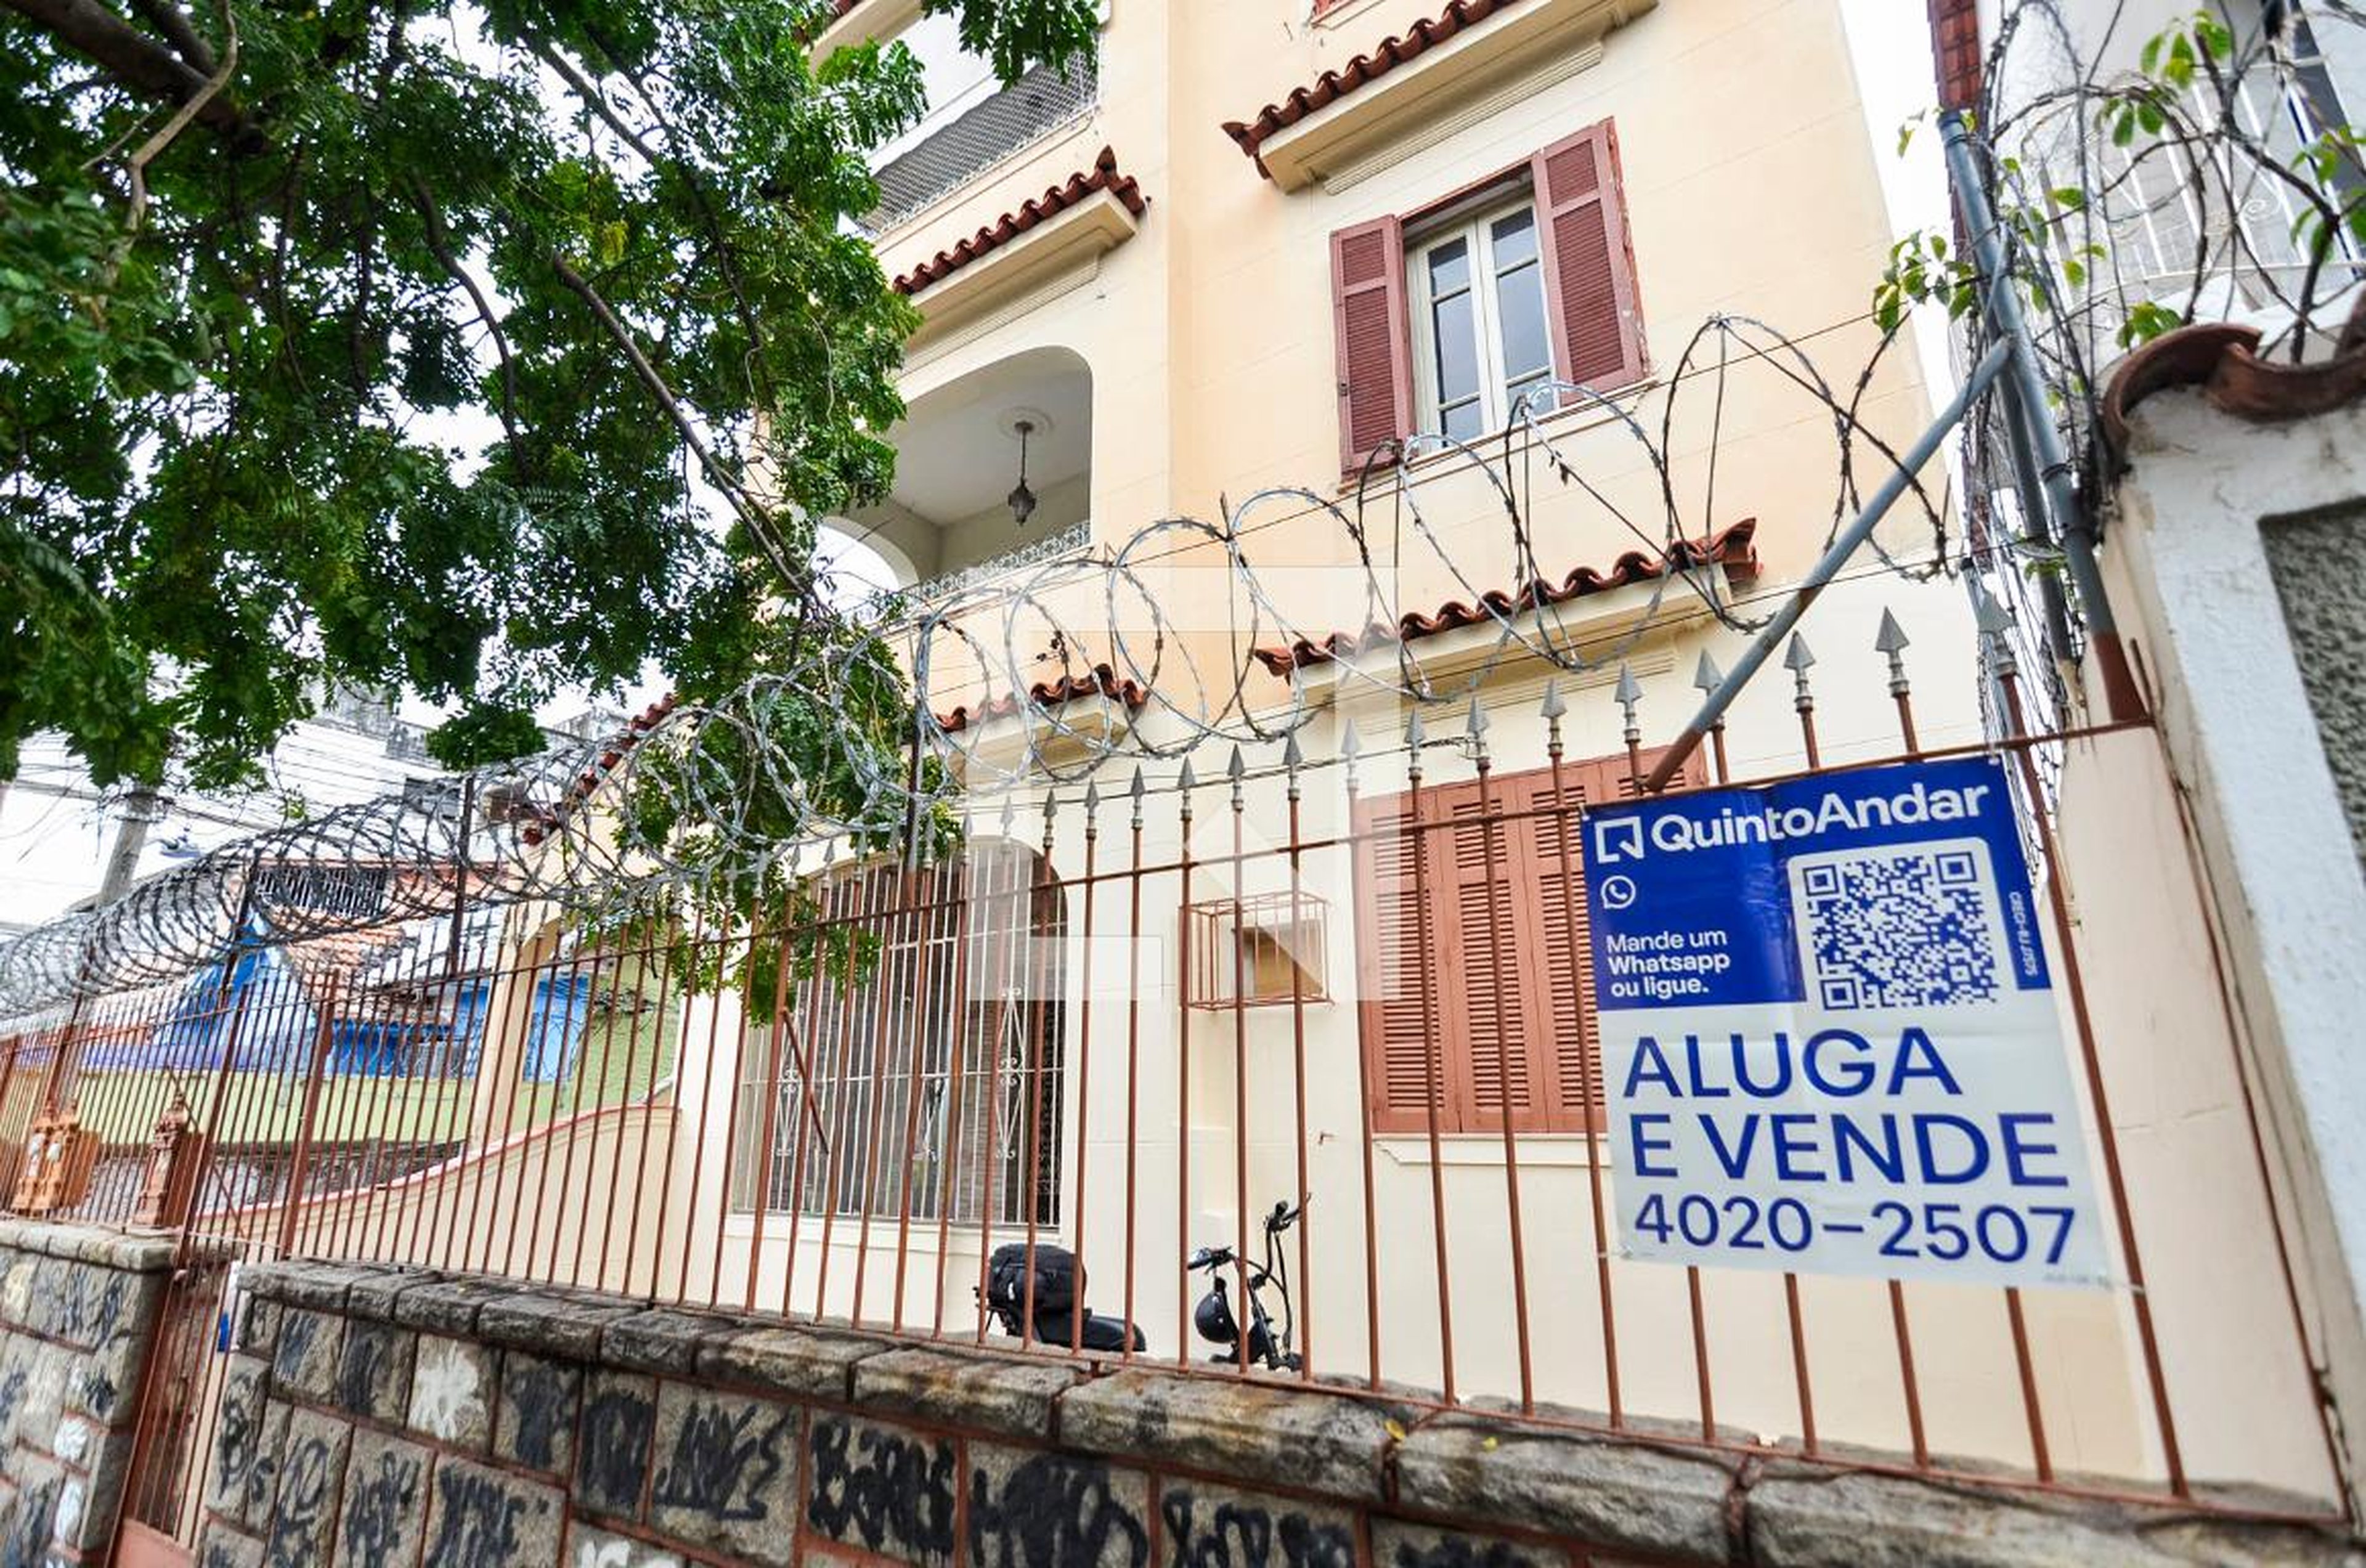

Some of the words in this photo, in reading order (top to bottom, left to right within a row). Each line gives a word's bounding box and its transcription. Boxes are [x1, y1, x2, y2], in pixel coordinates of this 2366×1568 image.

[1651, 783, 1988, 851] QuintoAndar
[1606, 930, 1684, 954] Mande
[1689, 930, 1727, 948] um
[1607, 953, 1730, 975] Whatsapp
[1611, 981, 1640, 997] ou
[1643, 976, 1709, 999] ligue.
[1624, 1028, 1962, 1099] ALUGA
[1630, 1114, 1678, 1177] E
[1698, 1114, 2068, 1187] VENDE
[1635, 1195, 2075, 1264] 4020-2507
